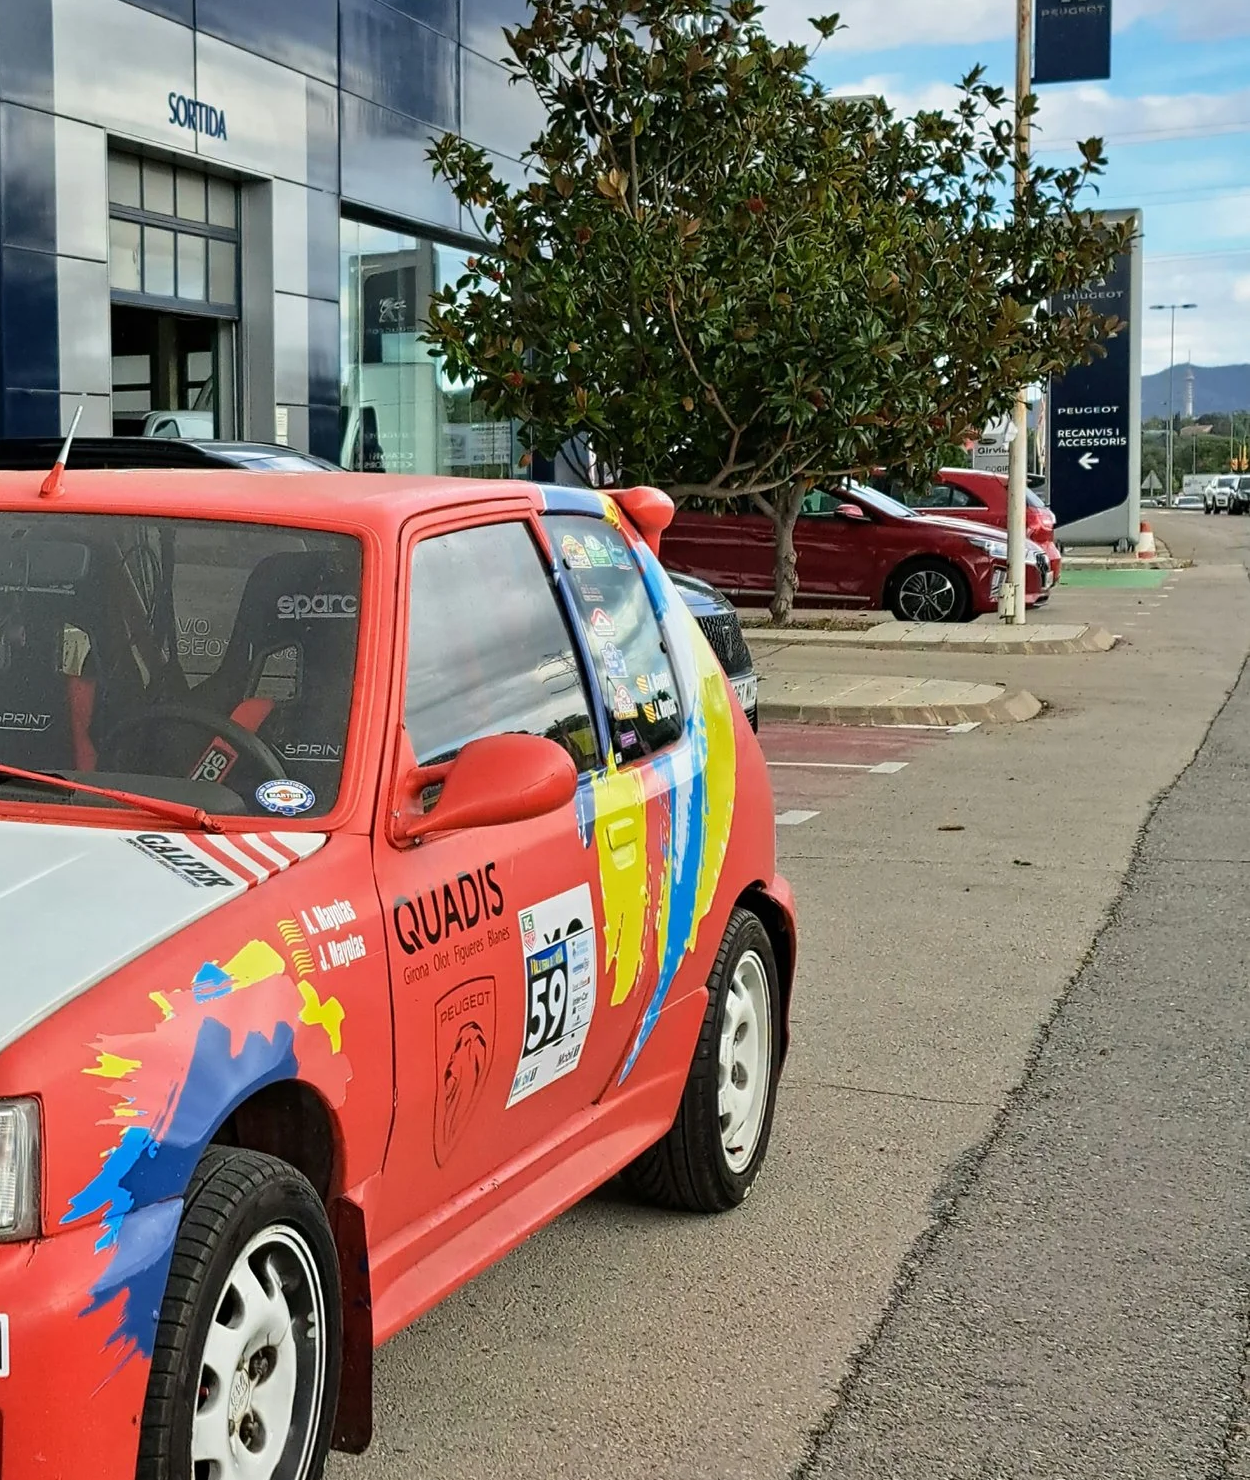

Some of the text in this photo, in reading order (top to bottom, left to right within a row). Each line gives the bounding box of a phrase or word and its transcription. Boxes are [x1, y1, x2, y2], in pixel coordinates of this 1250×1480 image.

[1041, 5, 1106, 17] PEUGEOT
[168, 92, 227, 140] SORTIDA
[1063, 291, 1123, 300] PEUGEOT
[1058, 406, 1120, 415] PEUGEOT
[1057, 428, 1114, 438] RECANVIS
[1057, 438, 1127, 447] ACCESSORIS
[136, 834, 235, 887] GALFER
[301, 899, 357, 935] A. Mayolas
[393, 861, 504, 955] QUADIS
[318, 933, 366, 971] J. Mayolas
[403, 963, 429, 985] Girona
[433, 950, 450, 972] Olot
[454, 938, 484, 965] Figueres
[487, 926, 510, 948] Blanes
[440, 991, 490, 1027] PEUGEOT
[526, 969, 566, 1050] 59
